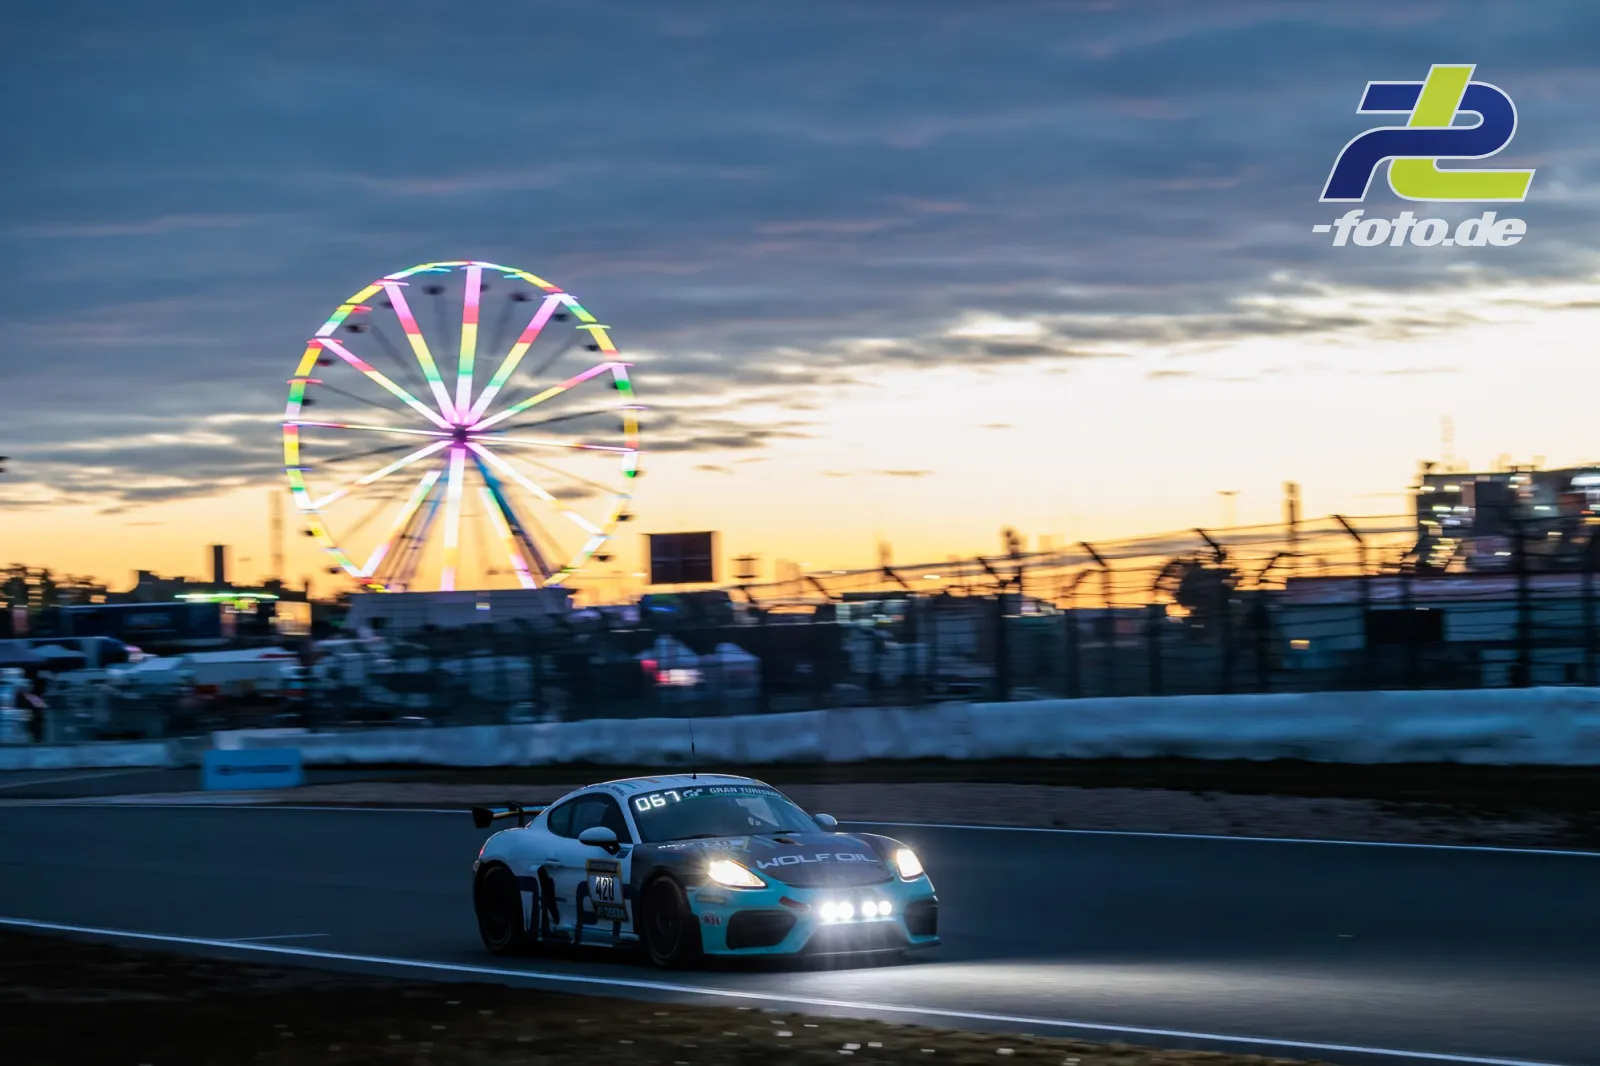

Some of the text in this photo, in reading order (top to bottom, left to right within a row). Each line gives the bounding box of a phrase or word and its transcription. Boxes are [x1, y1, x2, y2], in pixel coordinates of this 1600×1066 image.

[635, 790, 682, 812] 067
[756, 852, 878, 870] WOLF OIL
[595, 876, 615, 901] 420
